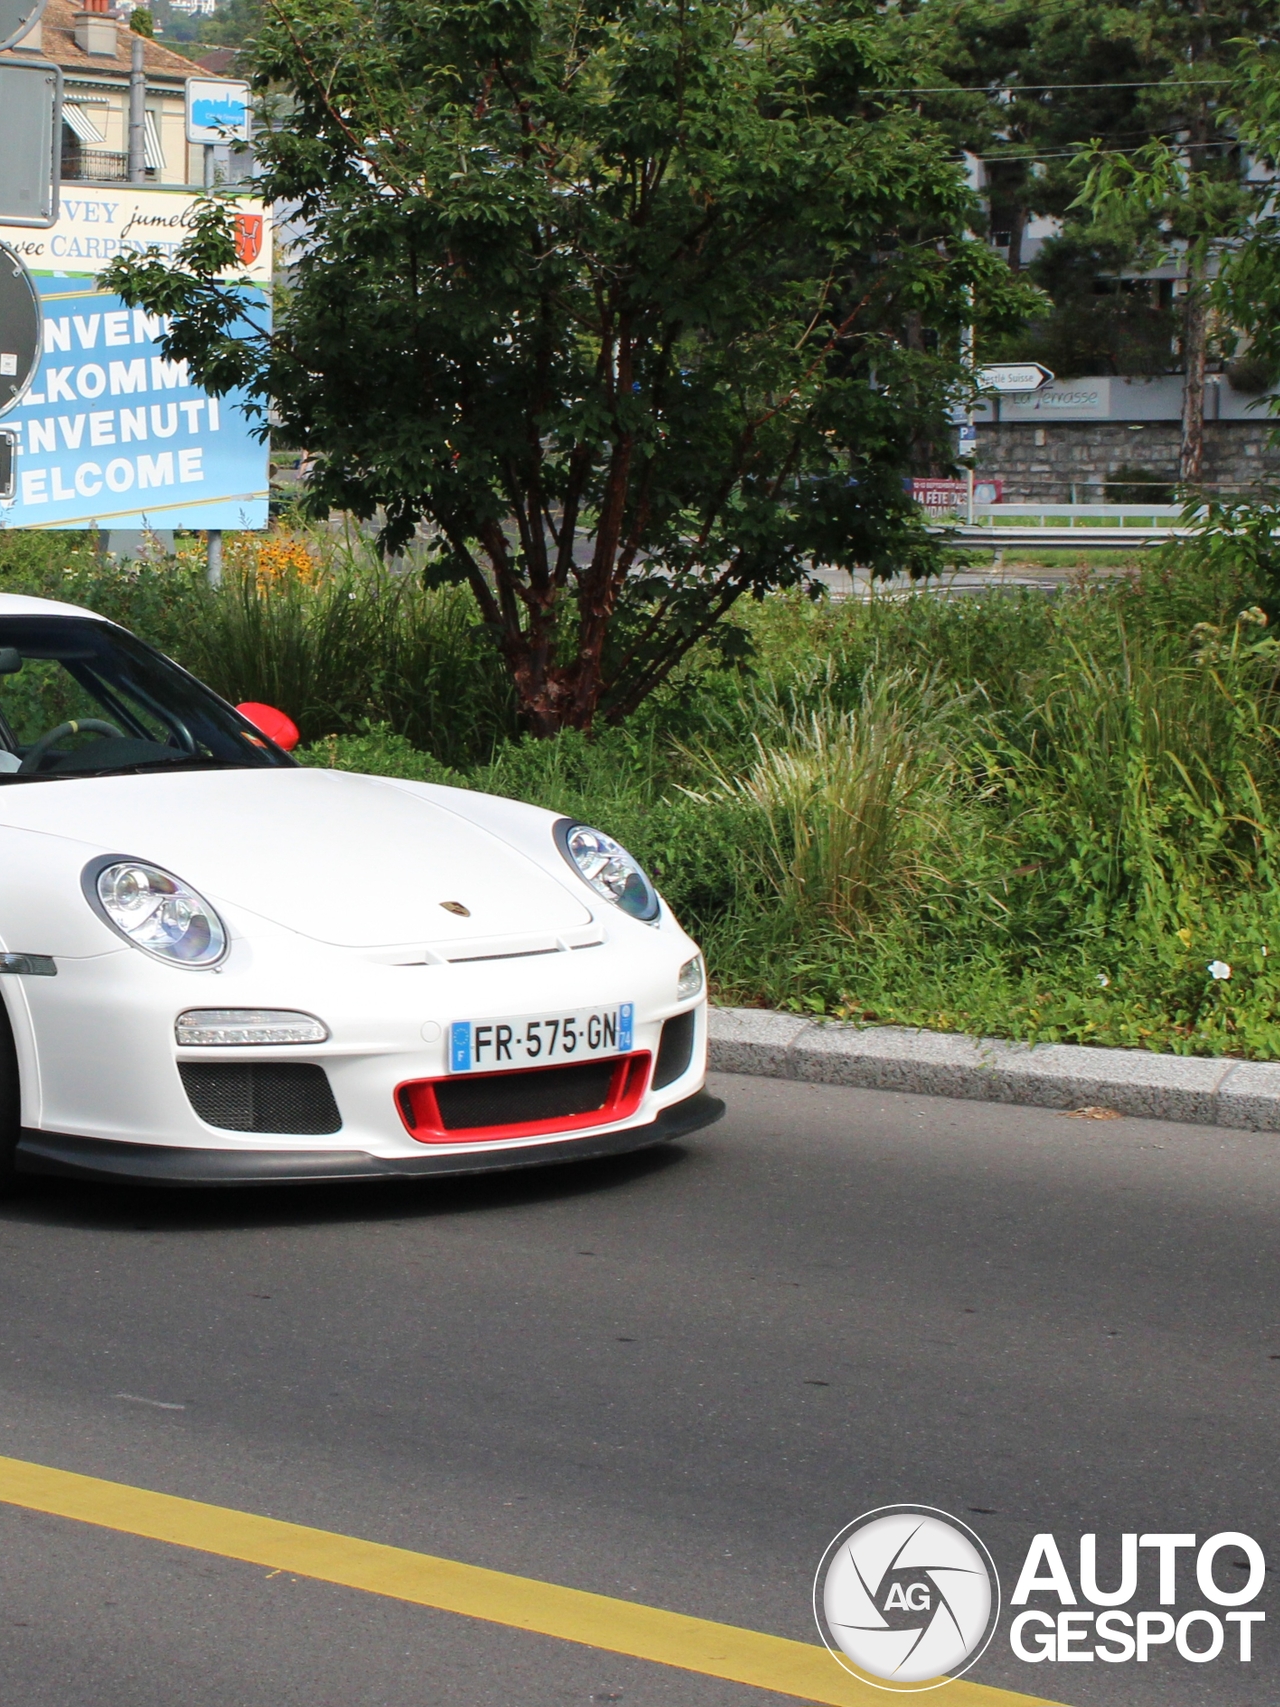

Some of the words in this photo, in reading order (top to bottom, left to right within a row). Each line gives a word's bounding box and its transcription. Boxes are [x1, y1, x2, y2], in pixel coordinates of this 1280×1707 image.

[58, 200, 119, 224] VEY
[1008, 373, 1034, 383] Suisse
[961, 427, 969, 439] P
[926, 489, 949, 505] FÊTE
[619, 1031, 631, 1048] 74
